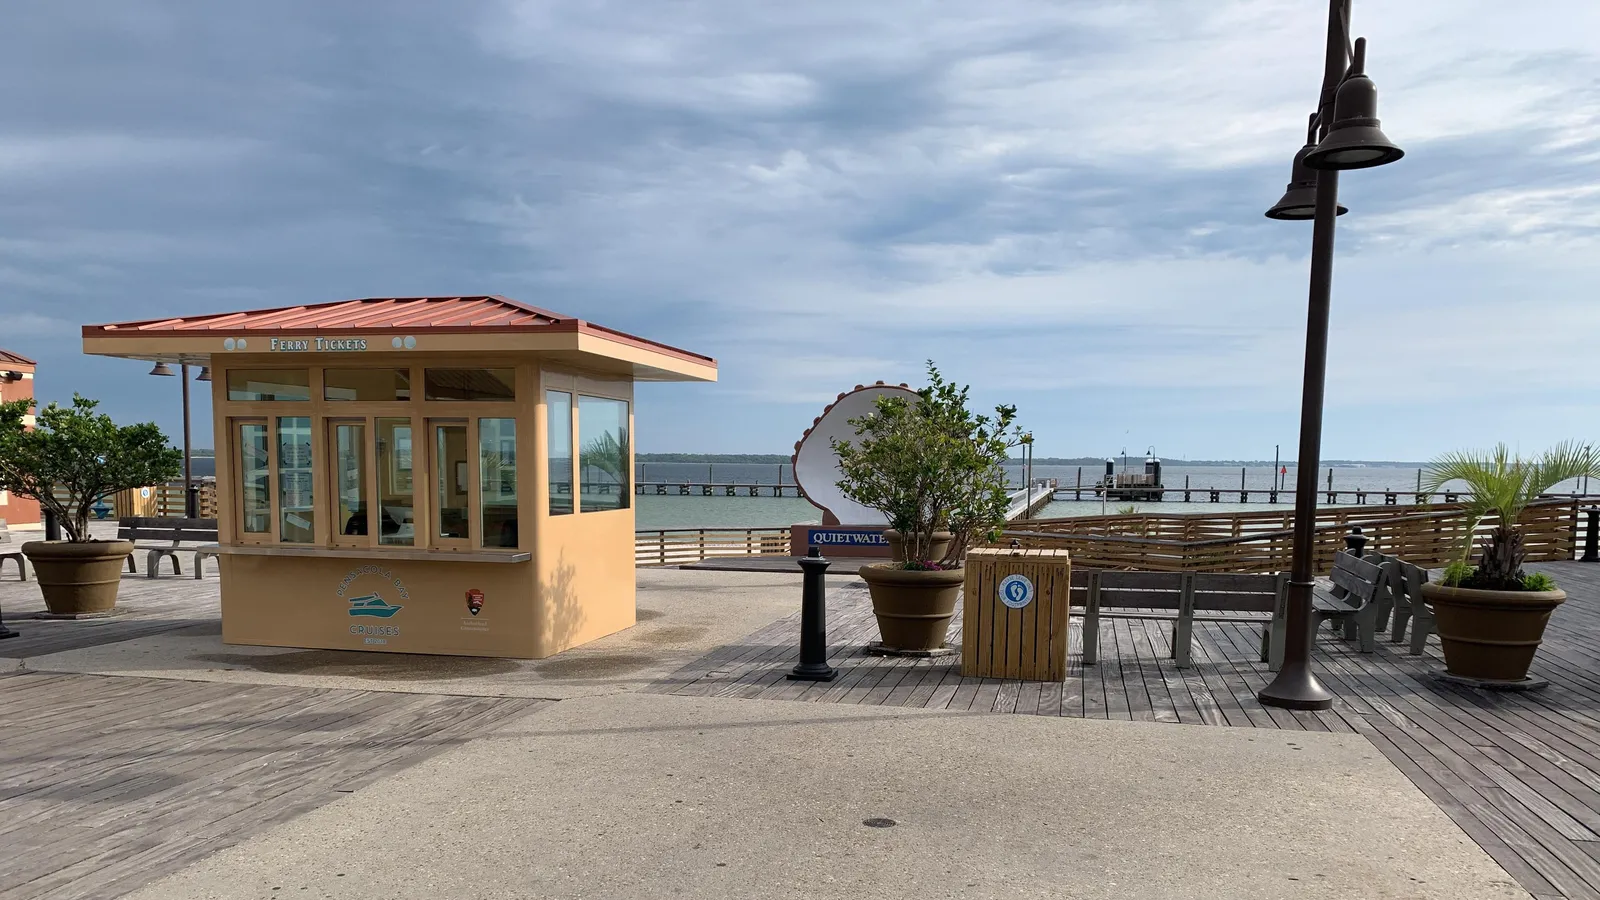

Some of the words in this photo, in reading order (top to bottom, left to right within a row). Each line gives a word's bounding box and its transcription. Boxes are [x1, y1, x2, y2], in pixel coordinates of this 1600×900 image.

[813, 532, 890, 544] QUIETWATE
[336, 565, 392, 597] PENSACOLA
[393, 578, 410, 599] BAY
[349, 624, 400, 636] CRUISES
